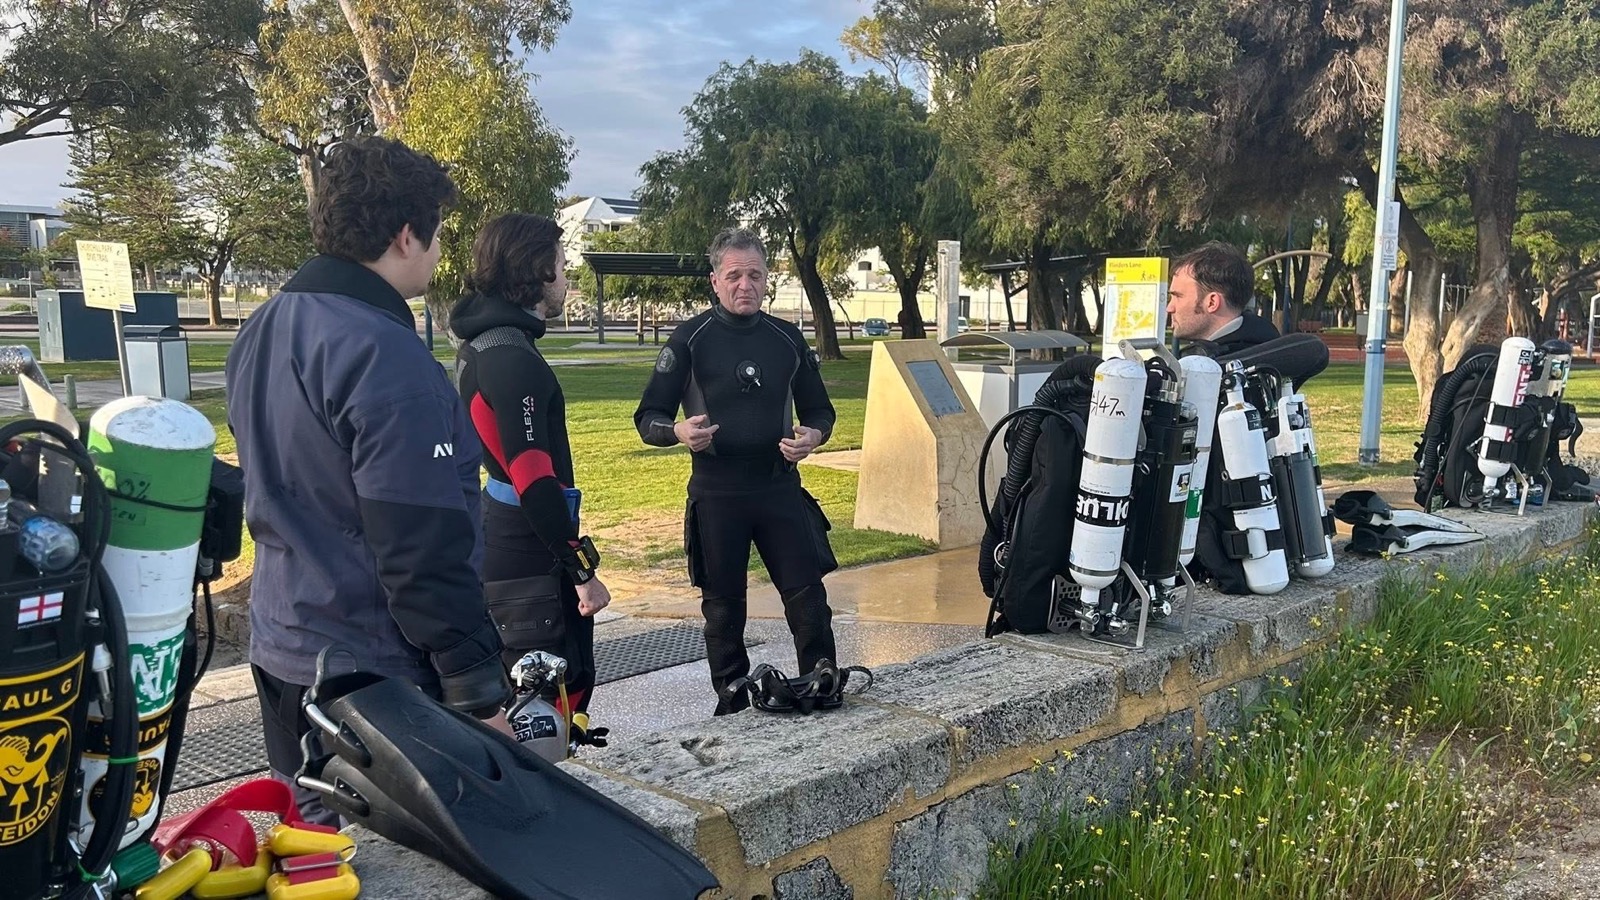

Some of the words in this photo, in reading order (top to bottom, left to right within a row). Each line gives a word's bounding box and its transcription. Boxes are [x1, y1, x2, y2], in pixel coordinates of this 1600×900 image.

[522, 395, 535, 442] FLEXA
[2, 688, 53, 711] AUL
[60, 678, 73, 695] G
